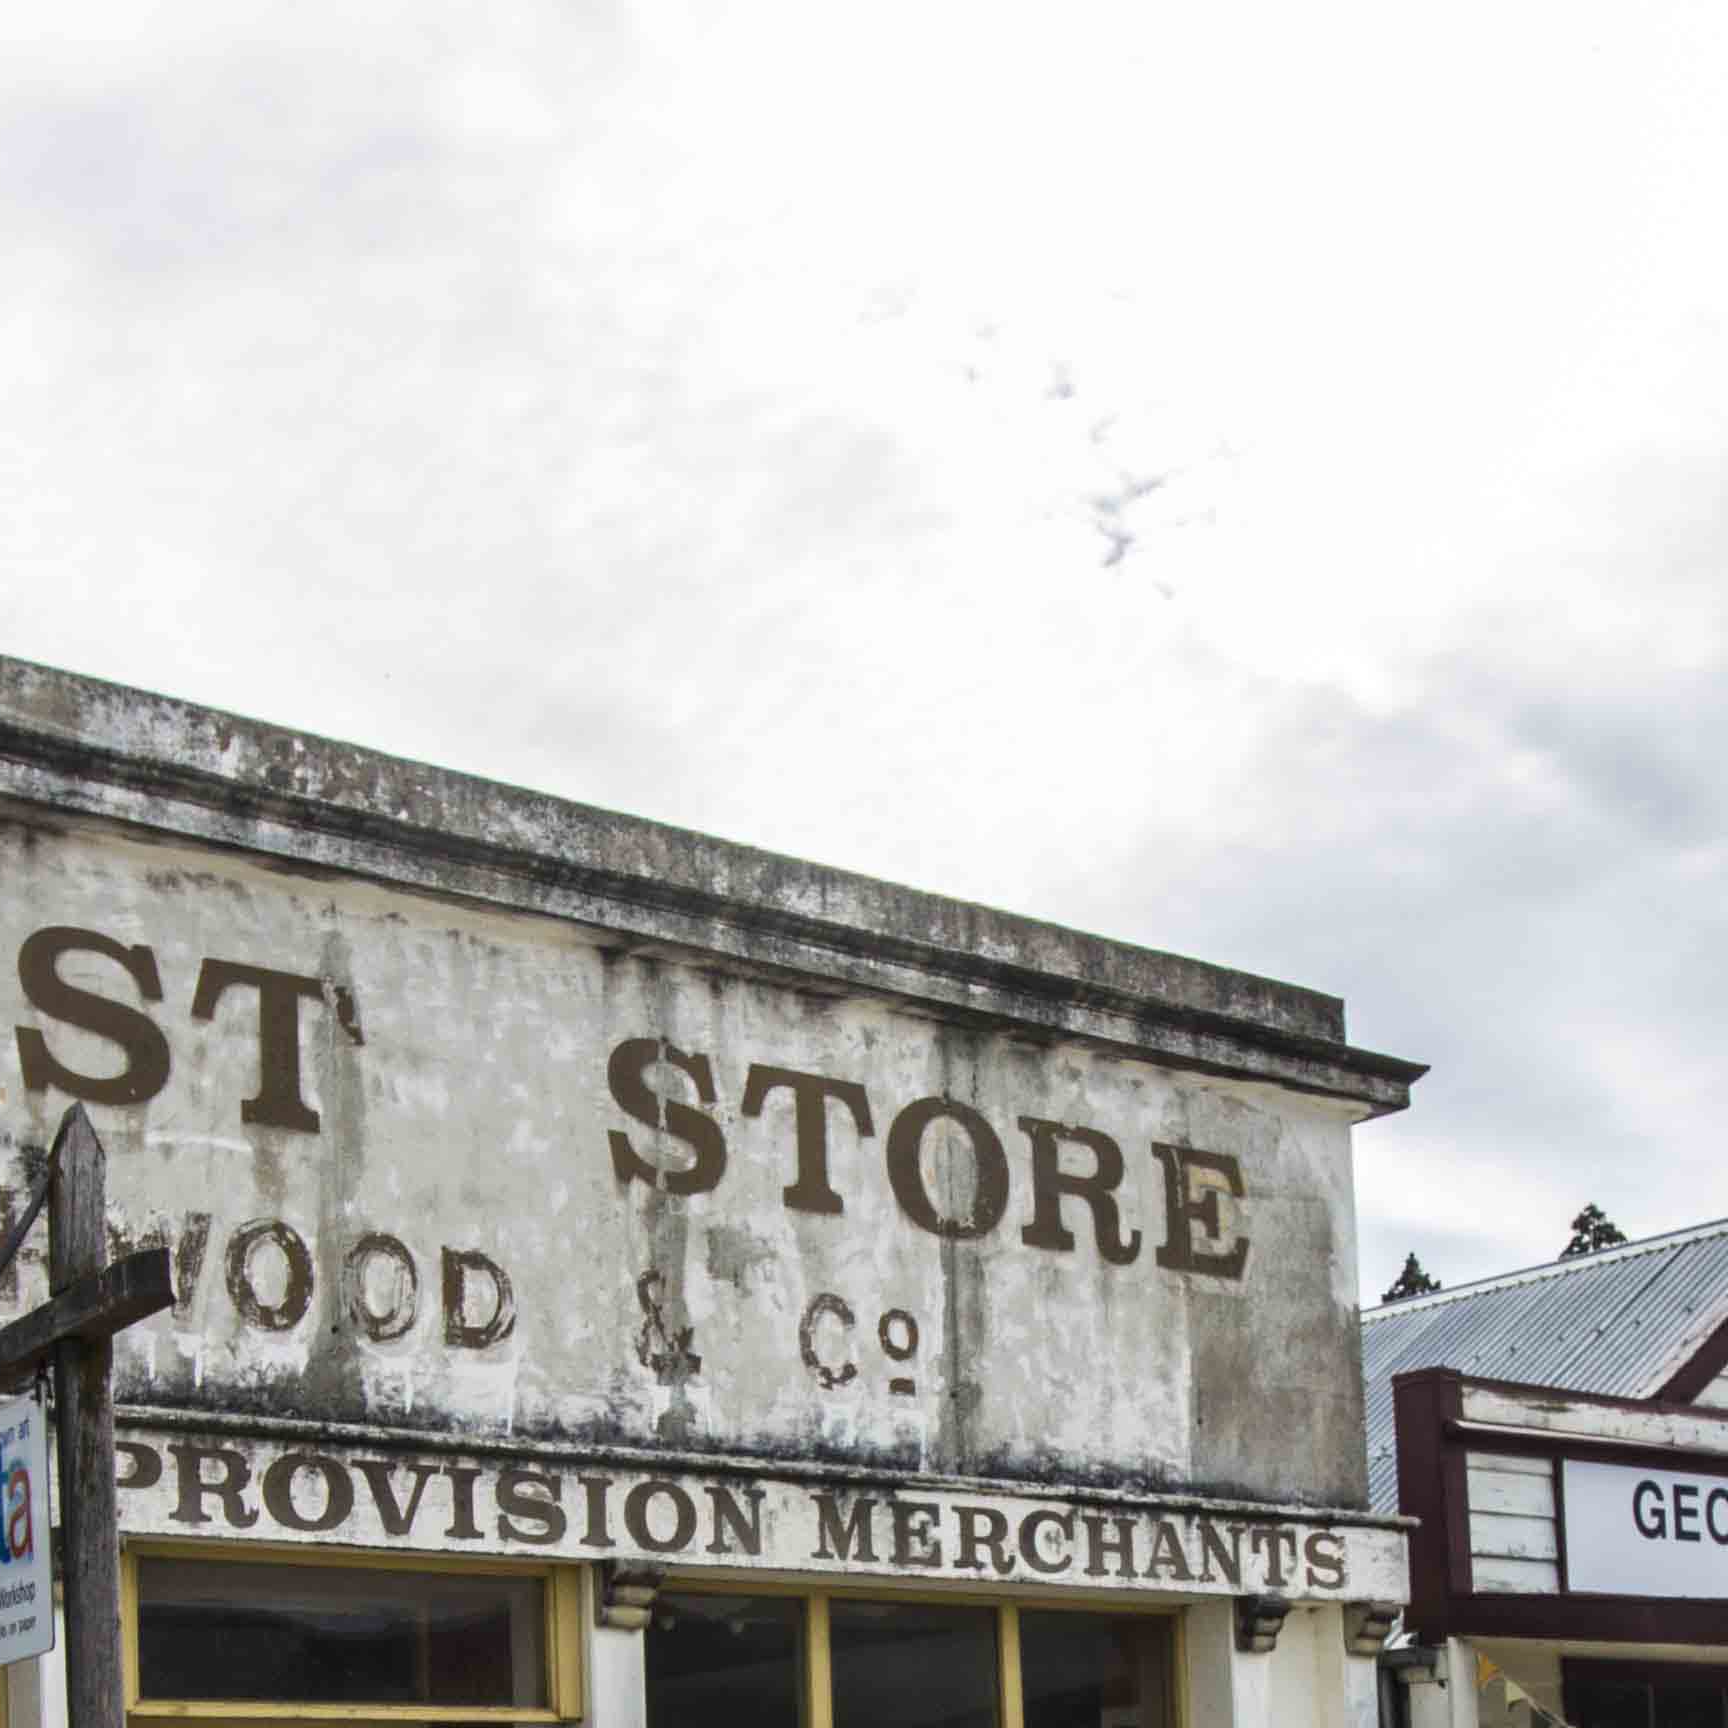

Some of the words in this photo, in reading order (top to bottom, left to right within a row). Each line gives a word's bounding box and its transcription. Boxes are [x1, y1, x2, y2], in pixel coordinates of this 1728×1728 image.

[607, 1038, 1250, 1281] STORE
[635, 1268, 702, 1385] &
[115, 1440, 766, 1557] PROVISION
[810, 1491, 1348, 1591] MERCHANTS
